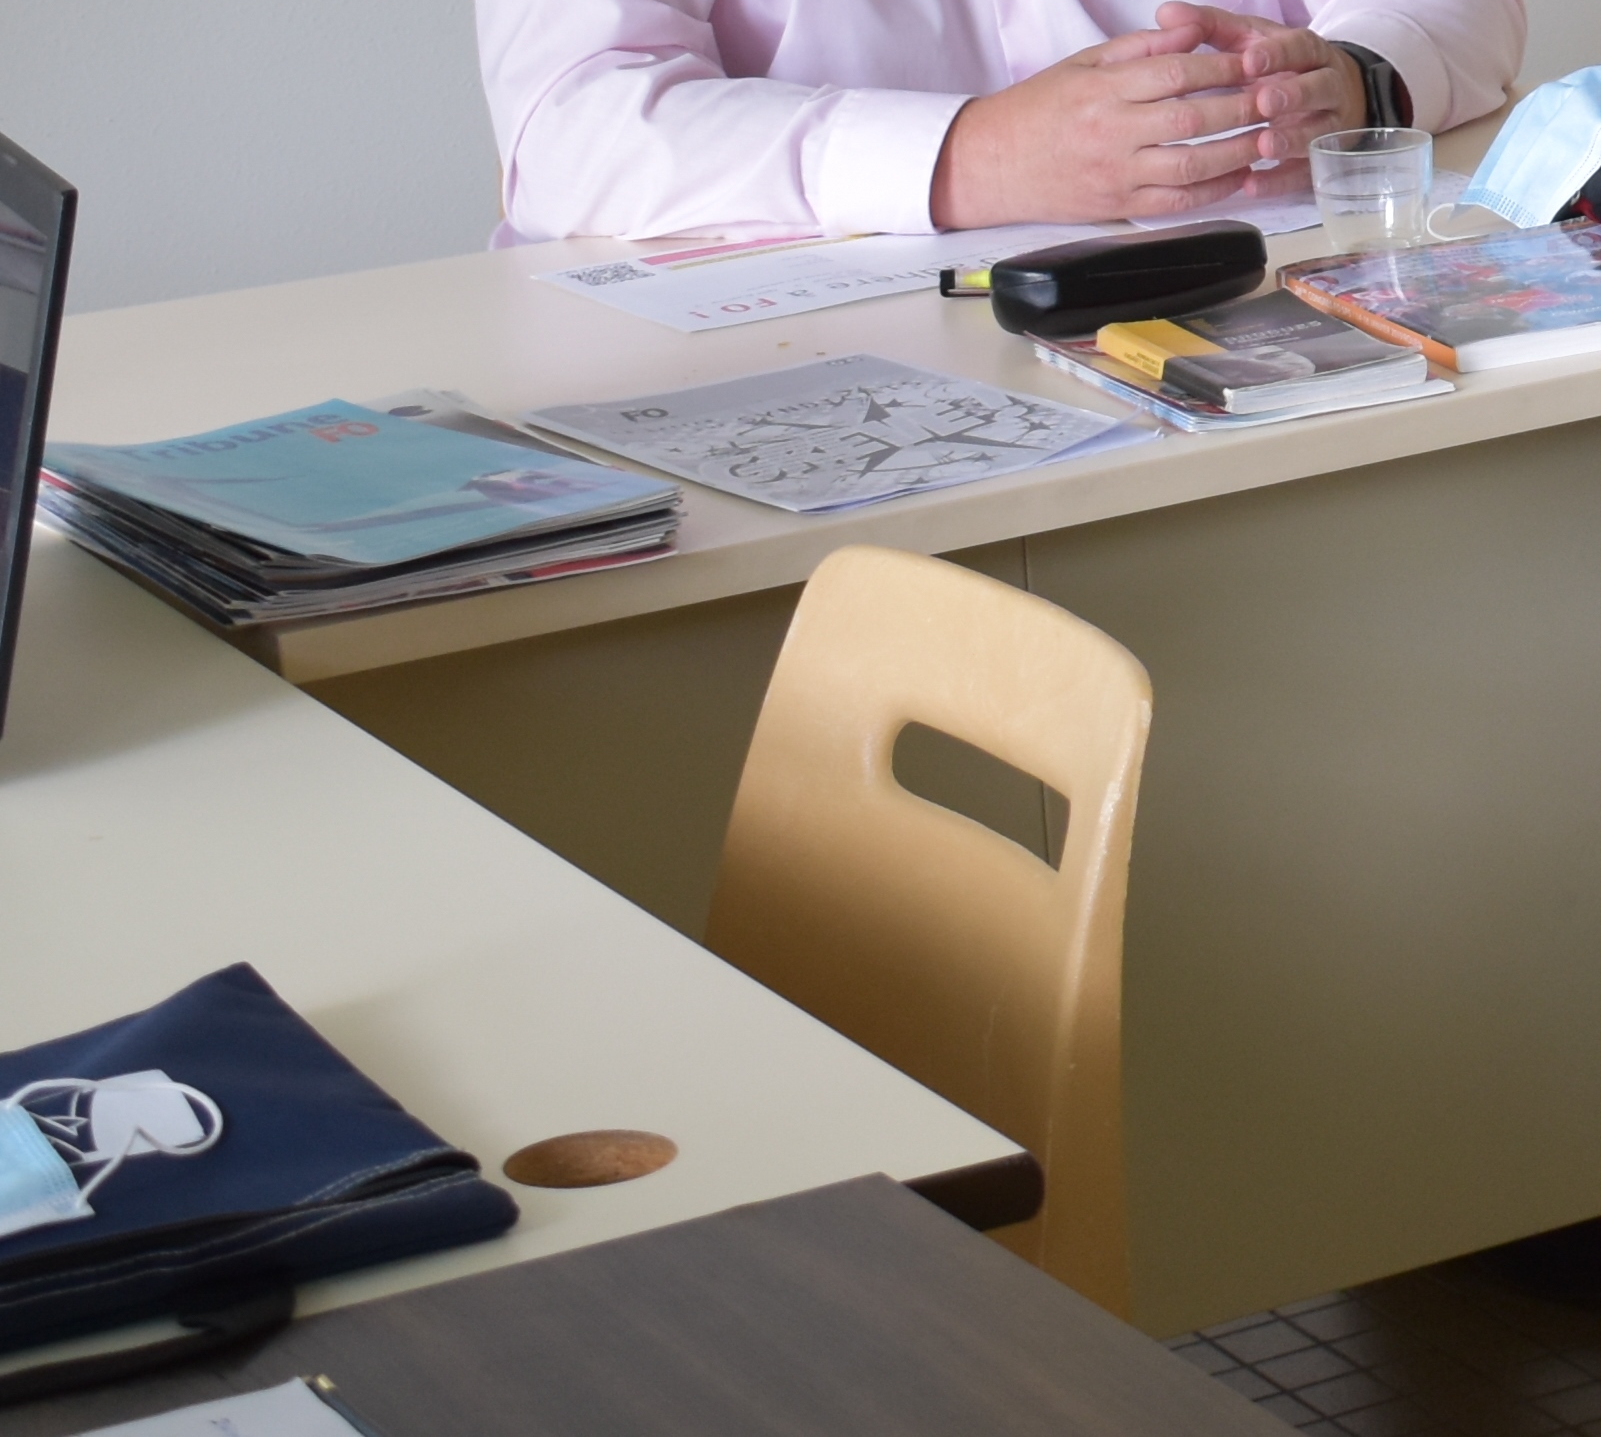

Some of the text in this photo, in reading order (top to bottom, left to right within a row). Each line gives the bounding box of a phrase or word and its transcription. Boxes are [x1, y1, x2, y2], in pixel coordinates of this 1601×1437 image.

[719, 297, 778, 313] FO
[102, 412, 349, 463] Tribune
[311, 421, 379, 444] FO
